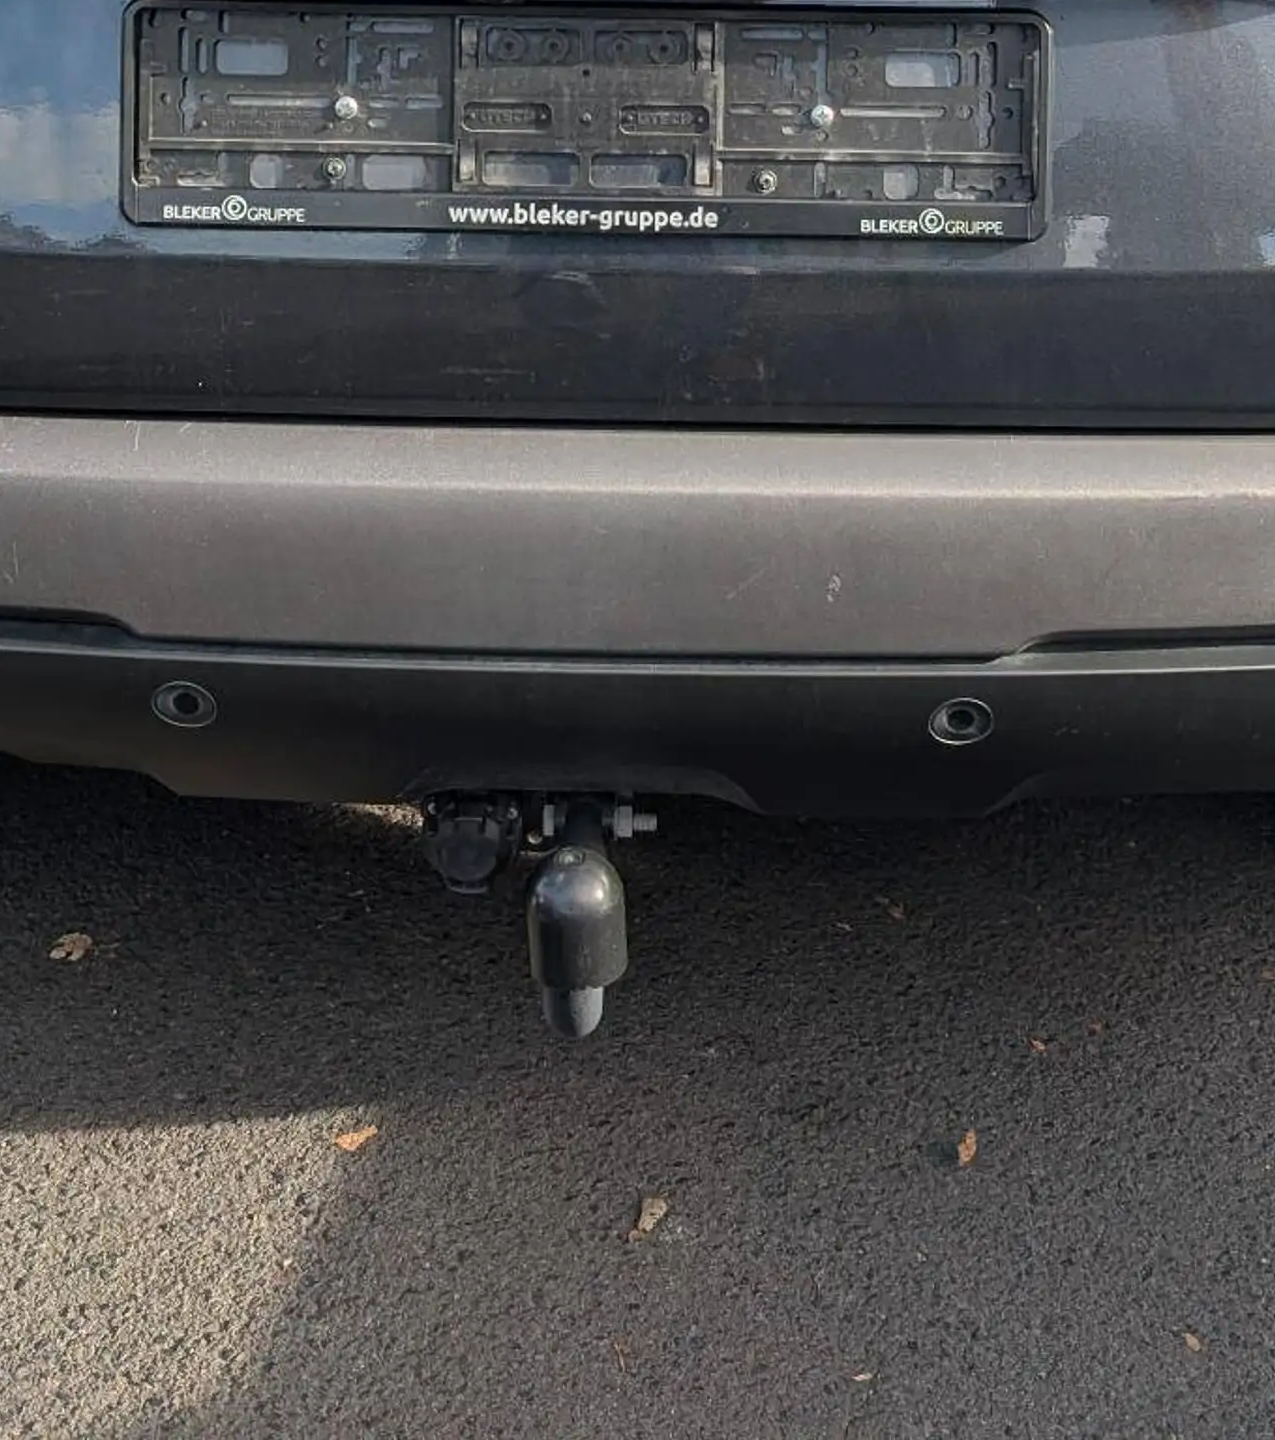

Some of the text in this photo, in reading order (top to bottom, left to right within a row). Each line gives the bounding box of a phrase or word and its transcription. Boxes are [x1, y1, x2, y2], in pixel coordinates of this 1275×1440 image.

[163, 205, 305, 222] BLEKER GRUPPE
[448, 202, 719, 231] www.bleker-gruppe.de
[860, 218, 1004, 235] BLEKER GRUPPE
